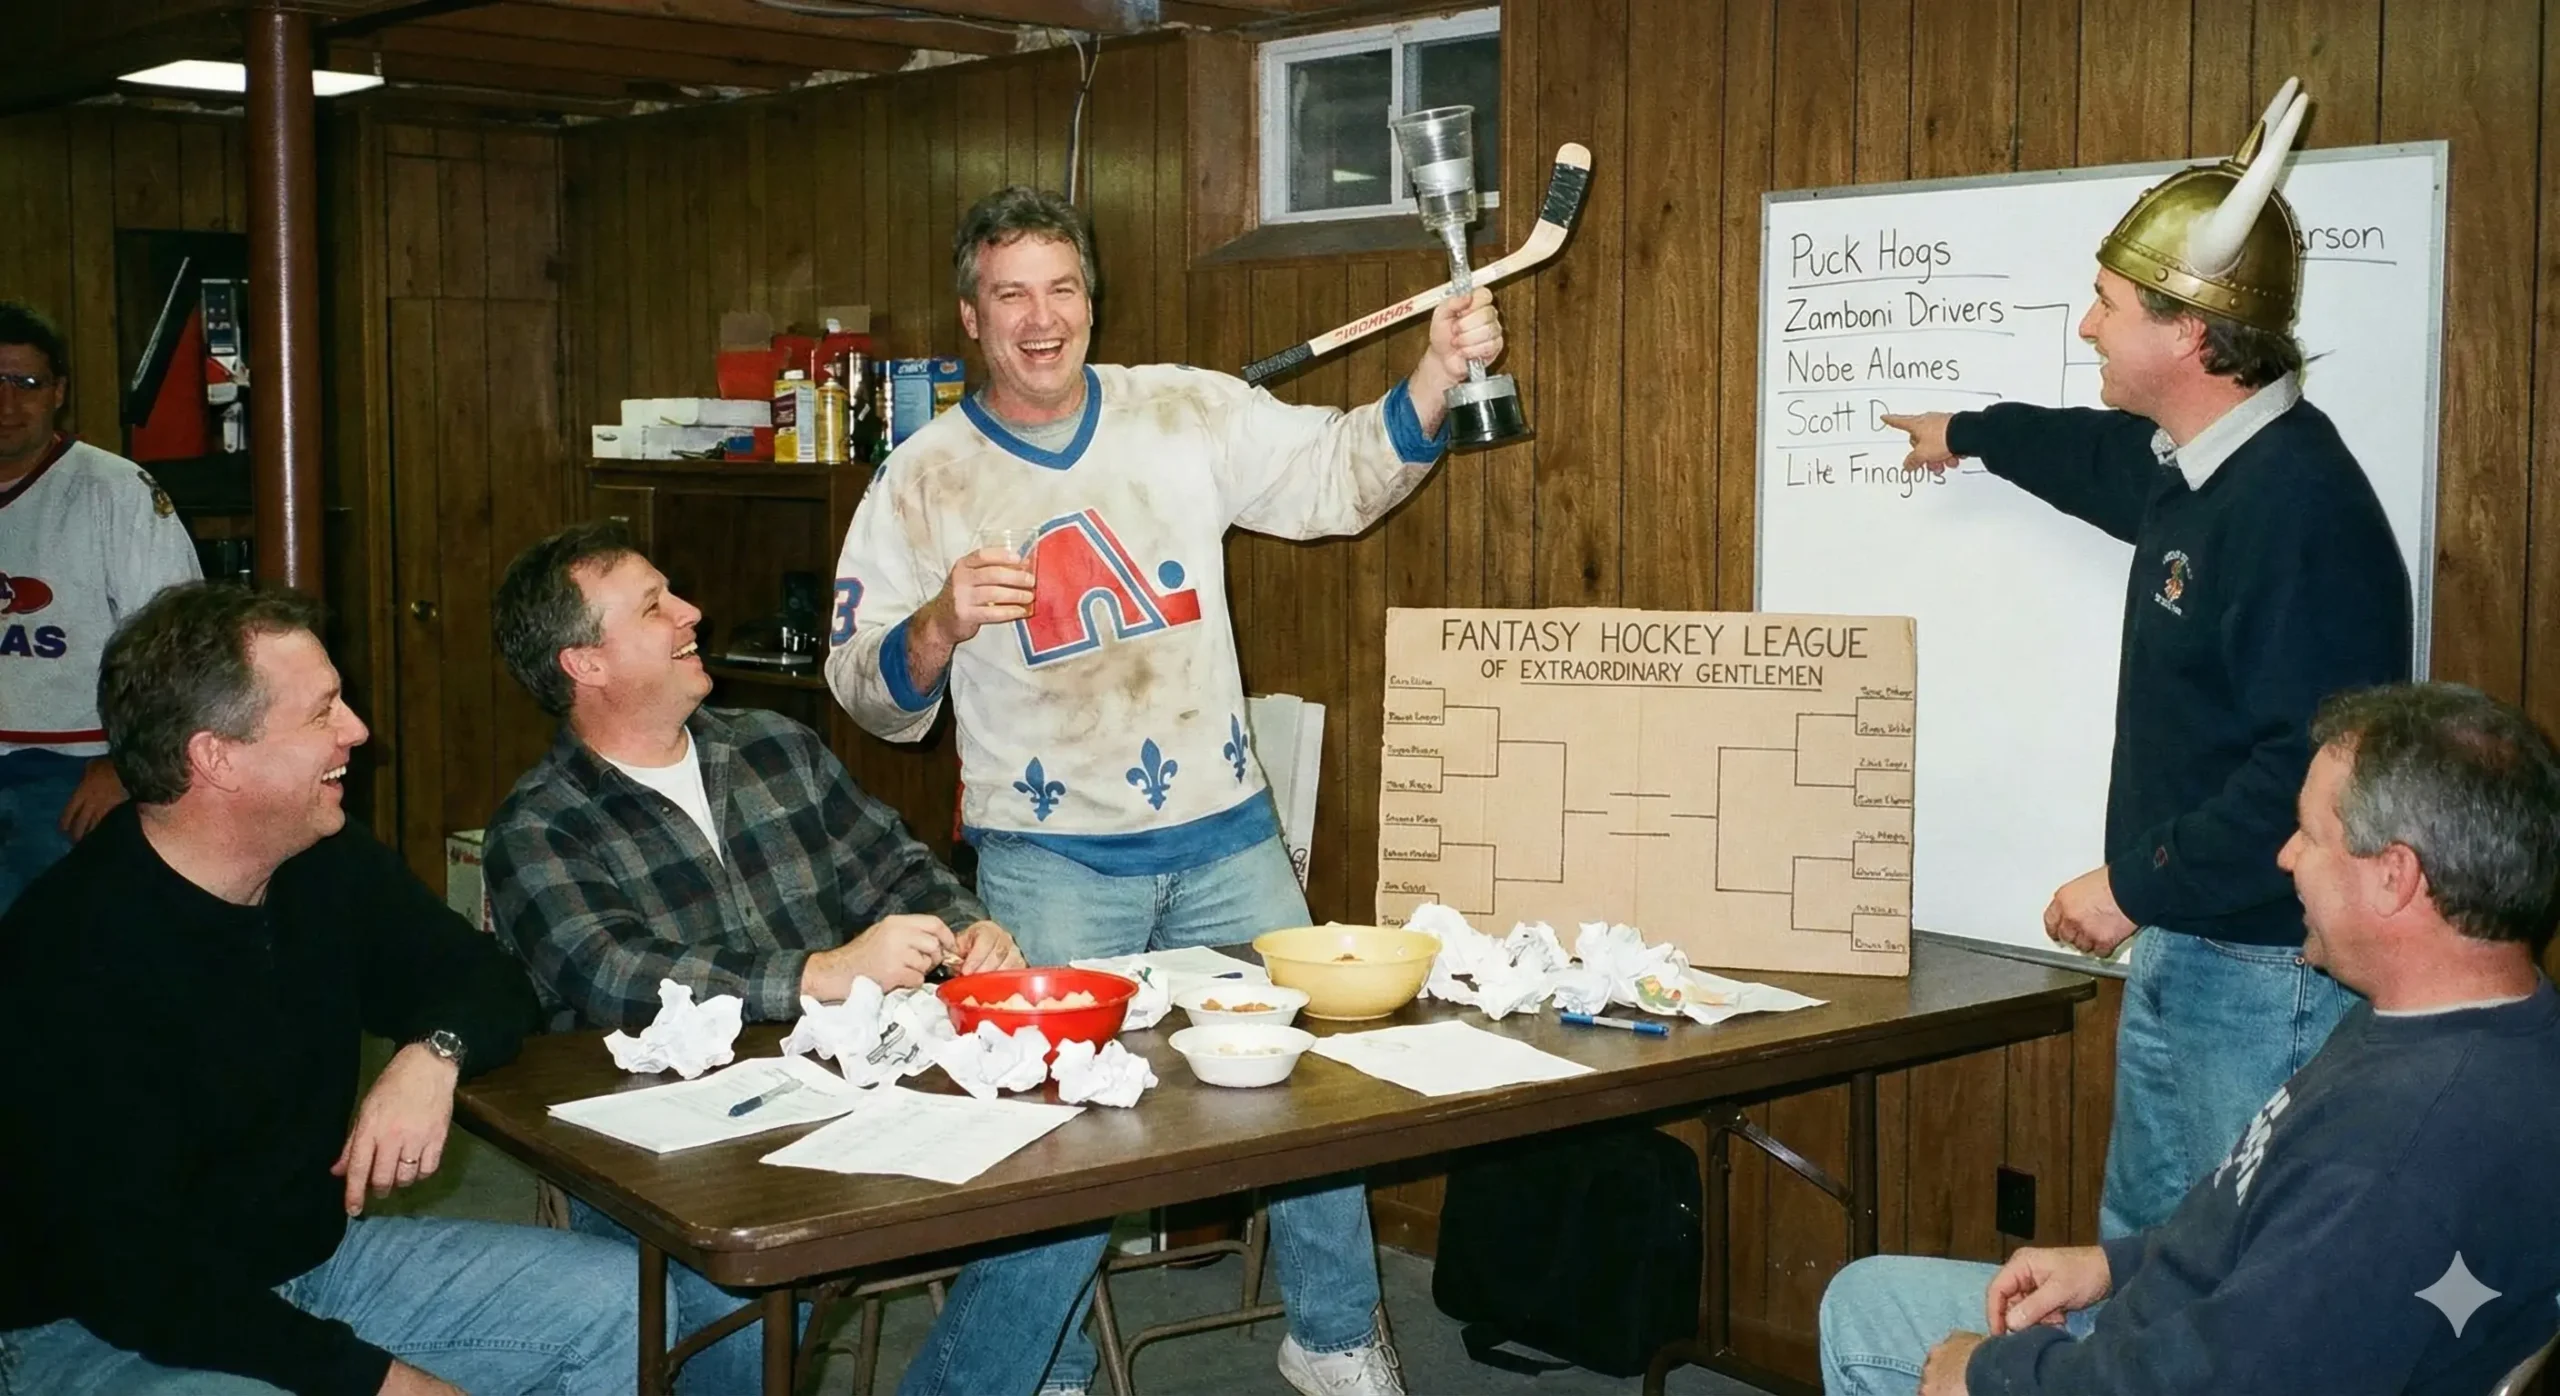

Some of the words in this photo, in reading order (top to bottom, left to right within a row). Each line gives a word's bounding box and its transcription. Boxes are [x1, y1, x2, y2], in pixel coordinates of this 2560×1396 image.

[1791, 232, 1862, 278] Puck
[1879, 228, 1951, 284] Hogs
[2305, 226, 2384, 250] rson
[1784, 298, 1892, 332] Zamboni
[1905, 291, 2004, 326] Drivers
[1788, 350, 1855, 383] Nobe
[1867, 346, 1960, 381] Alames
[1787, 399, 1856, 436] Scott
[831, 577, 864, 647] 3
[0, 623, 67, 659] AS
[1442, 618, 1580, 652] FANTASY
[1600, 621, 1725, 658] HOCKEY
[1744, 625, 1868, 659] LEAGUE
[1481, 658, 1508, 678] OF
[1520, 659, 1684, 682] EXTRAORDINARY
[1696, 662, 1823, 686] GENTLEMEN
